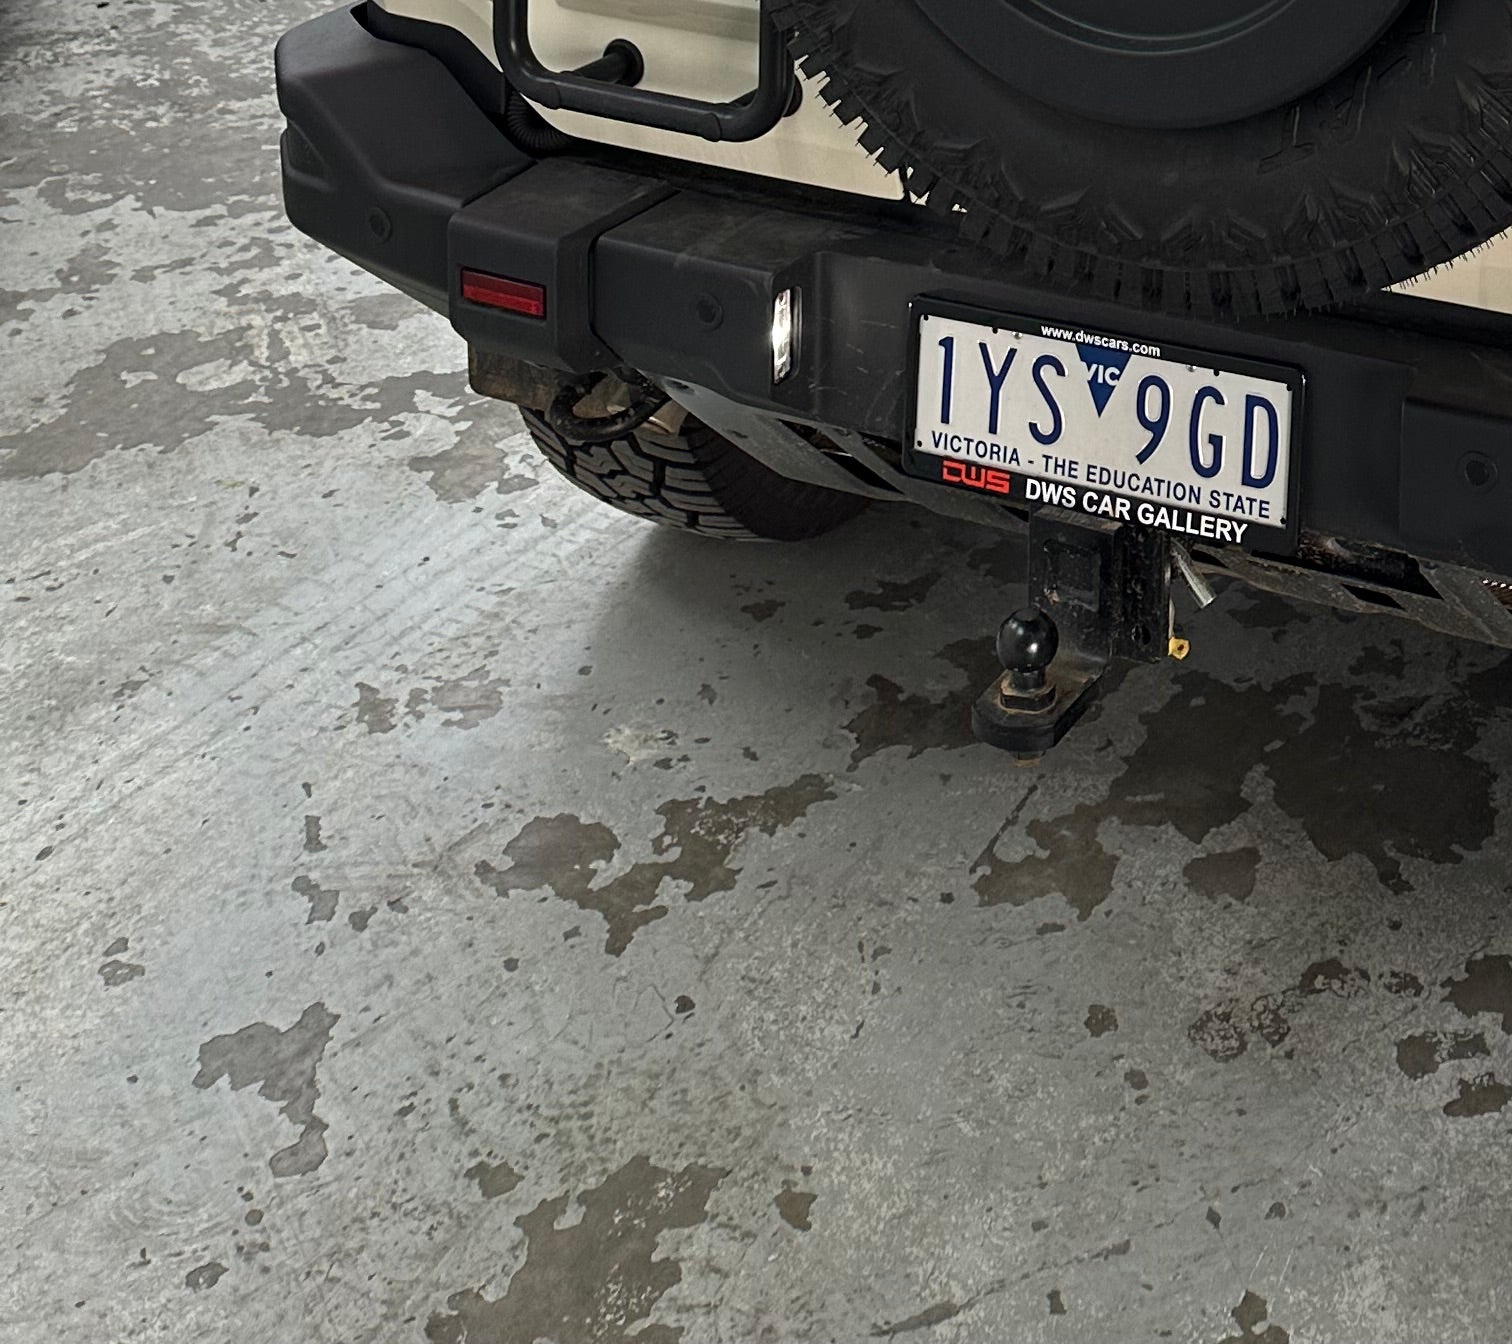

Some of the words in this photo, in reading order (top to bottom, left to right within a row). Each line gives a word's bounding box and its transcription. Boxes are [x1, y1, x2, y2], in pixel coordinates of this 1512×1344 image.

[1040, 325, 1161, 358] www.dwscars.com
[1082, 362, 1121, 387] VIC
[938, 335, 1067, 446] 1YS
[1135, 373, 1281, 490] 9GD
[931, 430, 1021, 466] VICTORIA
[1042, 454, 1079, 479] THE
[1086, 463, 1201, 505] EDUCATION
[1208, 489, 1270, 519] STATE
[942, 459, 1011, 494] DWS
[1025, 478, 1077, 508] DWS
[1082, 490, 1131, 521] CAR
[1136, 502, 1249, 544] GALLERY
